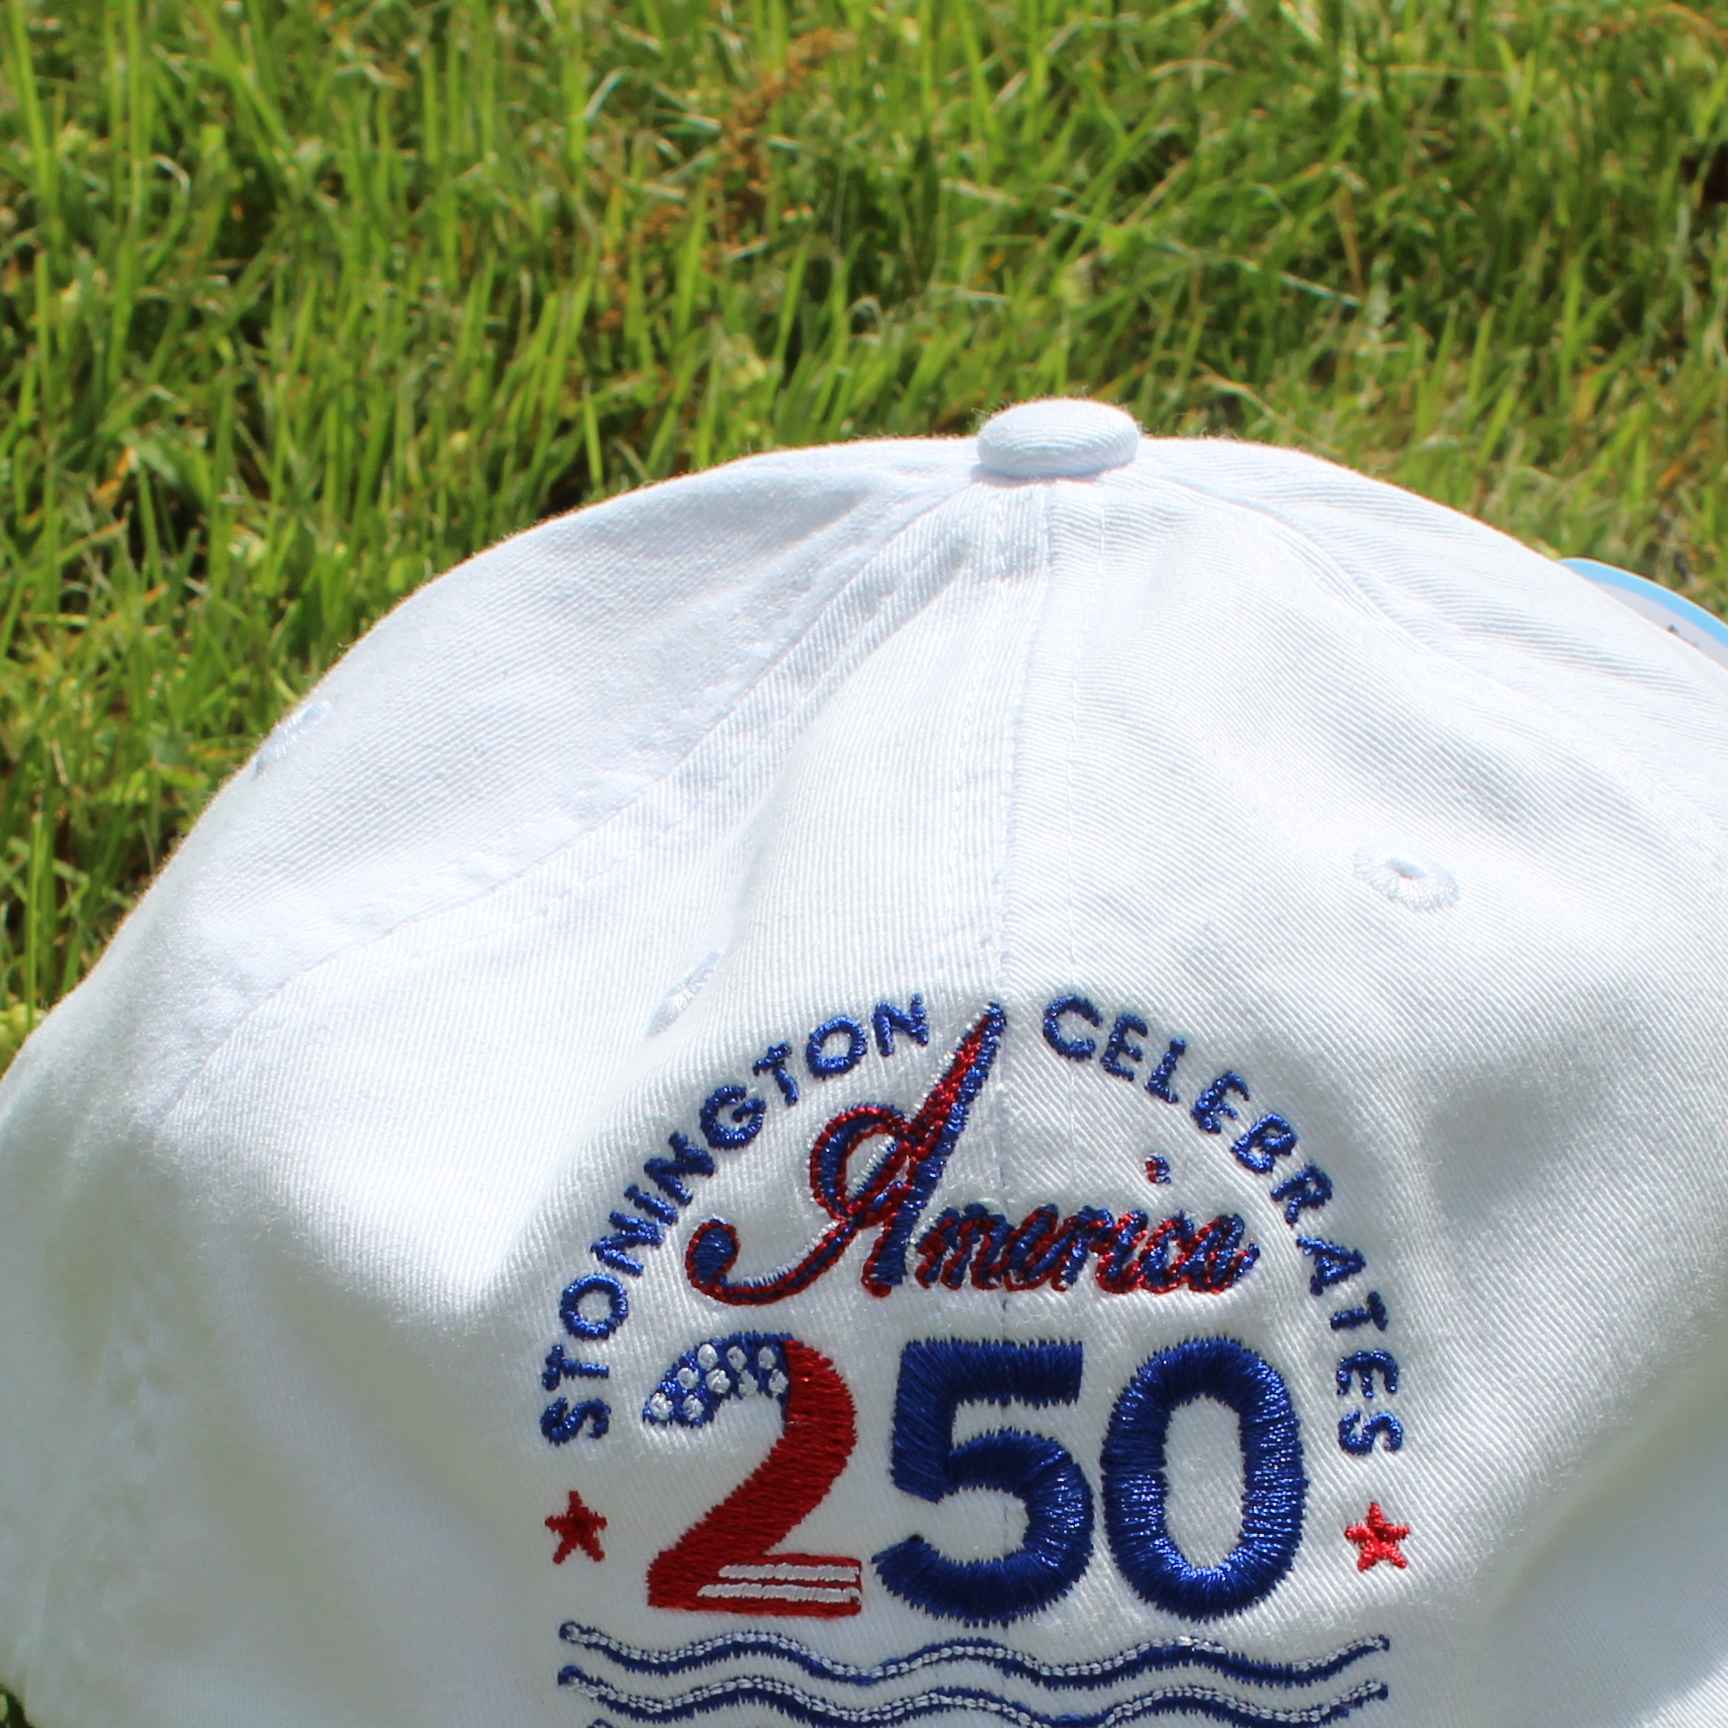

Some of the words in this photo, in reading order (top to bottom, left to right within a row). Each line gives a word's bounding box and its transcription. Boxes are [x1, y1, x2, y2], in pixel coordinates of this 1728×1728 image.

[541, 994, 929, 1446] STONINGTON
[1041, 995, 1404, 1456] CELEBRATES
[685, 1003, 1260, 1305] America
[642, 1331, 1309, 1627] 250
